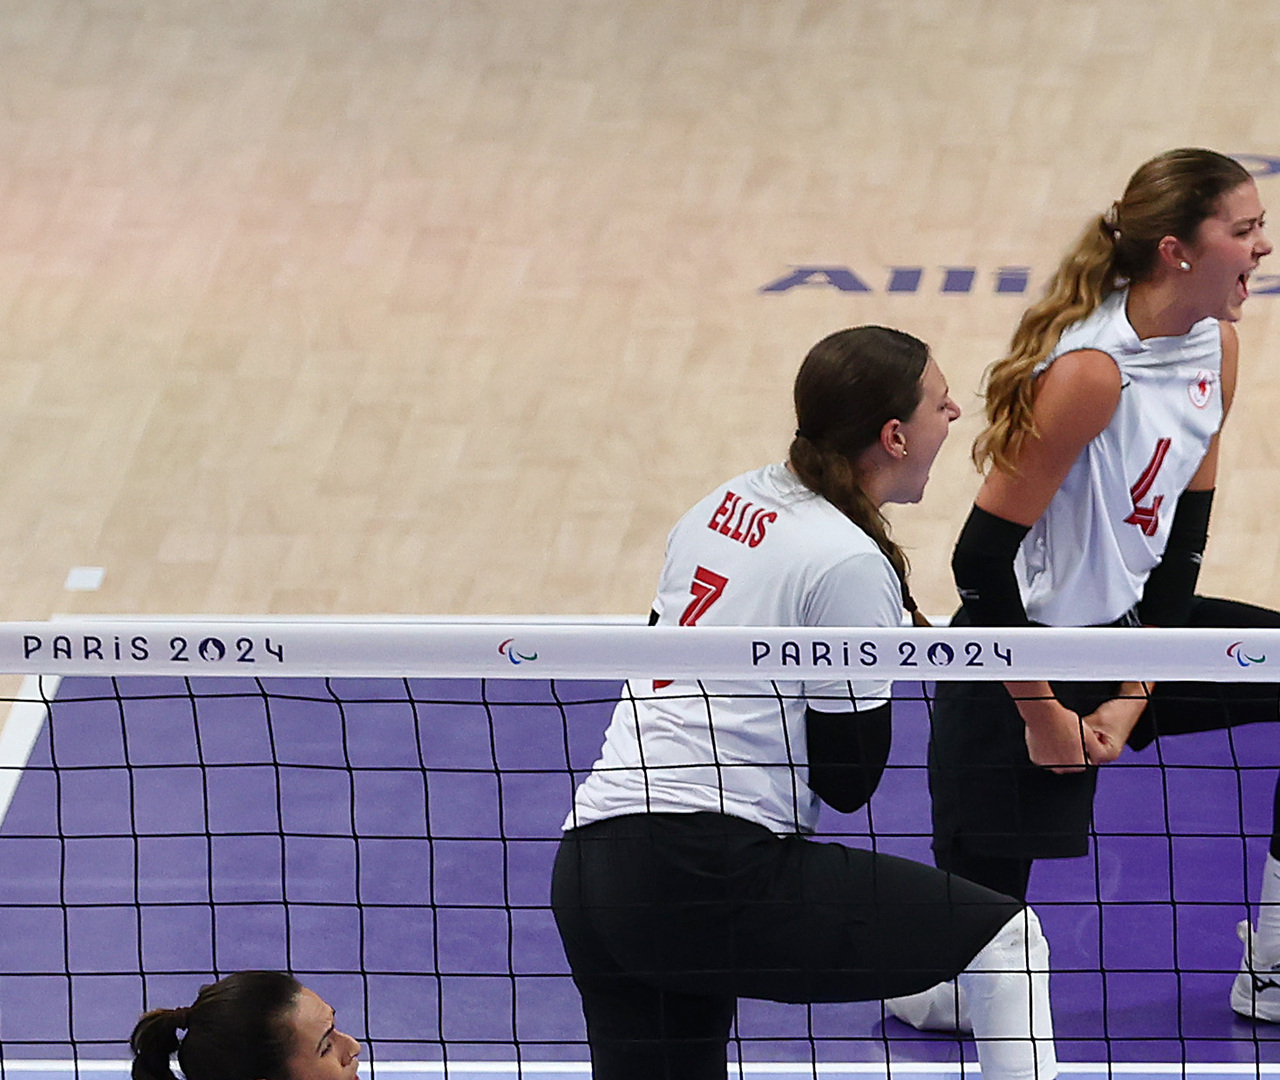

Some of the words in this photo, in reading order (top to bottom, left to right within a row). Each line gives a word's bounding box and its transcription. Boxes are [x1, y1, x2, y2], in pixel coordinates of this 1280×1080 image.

[1123, 437, 1172, 536] 4
[707, 490, 778, 548] ELLIS
[169, 636, 284, 663] 2024
[897, 640, 1012, 667] 2024
